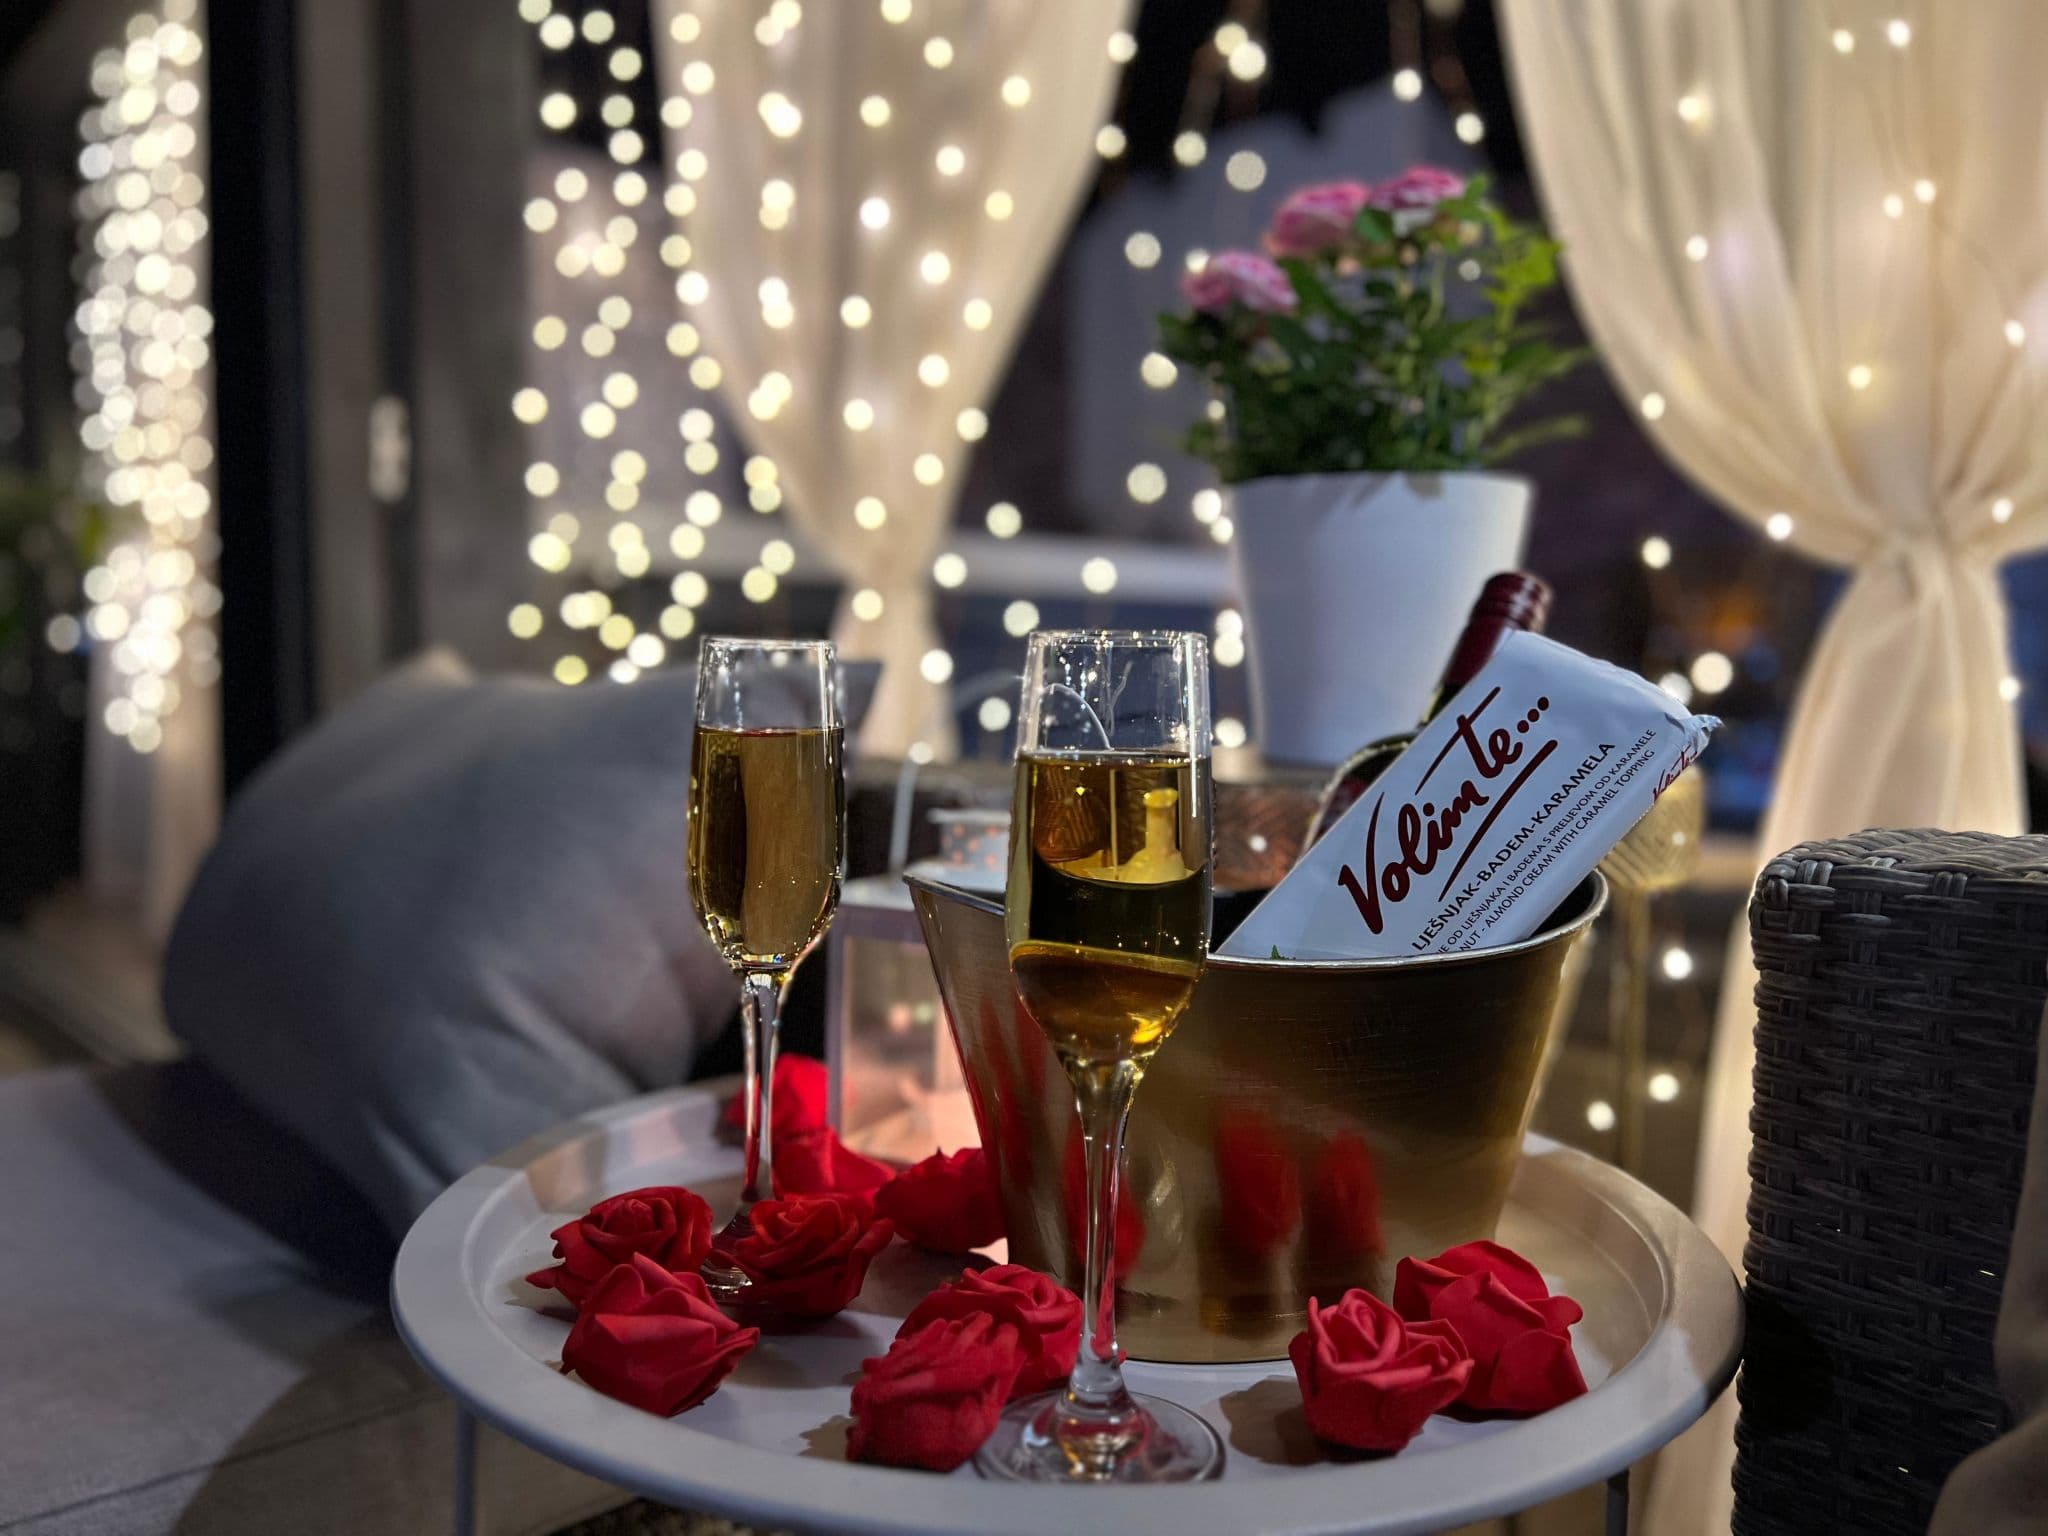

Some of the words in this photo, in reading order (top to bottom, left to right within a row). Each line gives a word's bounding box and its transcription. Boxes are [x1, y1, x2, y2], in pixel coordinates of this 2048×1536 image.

[1337, 780, 1490, 935] Volim
[1411, 742, 1616, 951] LJEŠNJAK-BADEM-KARAMELA
[1447, 929, 1463, 945] OD
[1461, 884, 1506, 930] LJEŠNJAKA
[1506, 844, 1547, 882] BADEMA
[1542, 836, 1552, 844] S
[1548, 789, 1598, 838] PRELJEVOM
[1594, 774, 1611, 791] OD
[1608, 729, 1657, 776] KARAMELE
[1485, 885, 1525, 928] ALMOND
[1521, 853, 1557, 887] CREAM
[1551, 828, 1579, 854] WITH
[1575, 788, 1620, 830] CARAMEL
[1614, 749, 1655, 788] TOPPING
